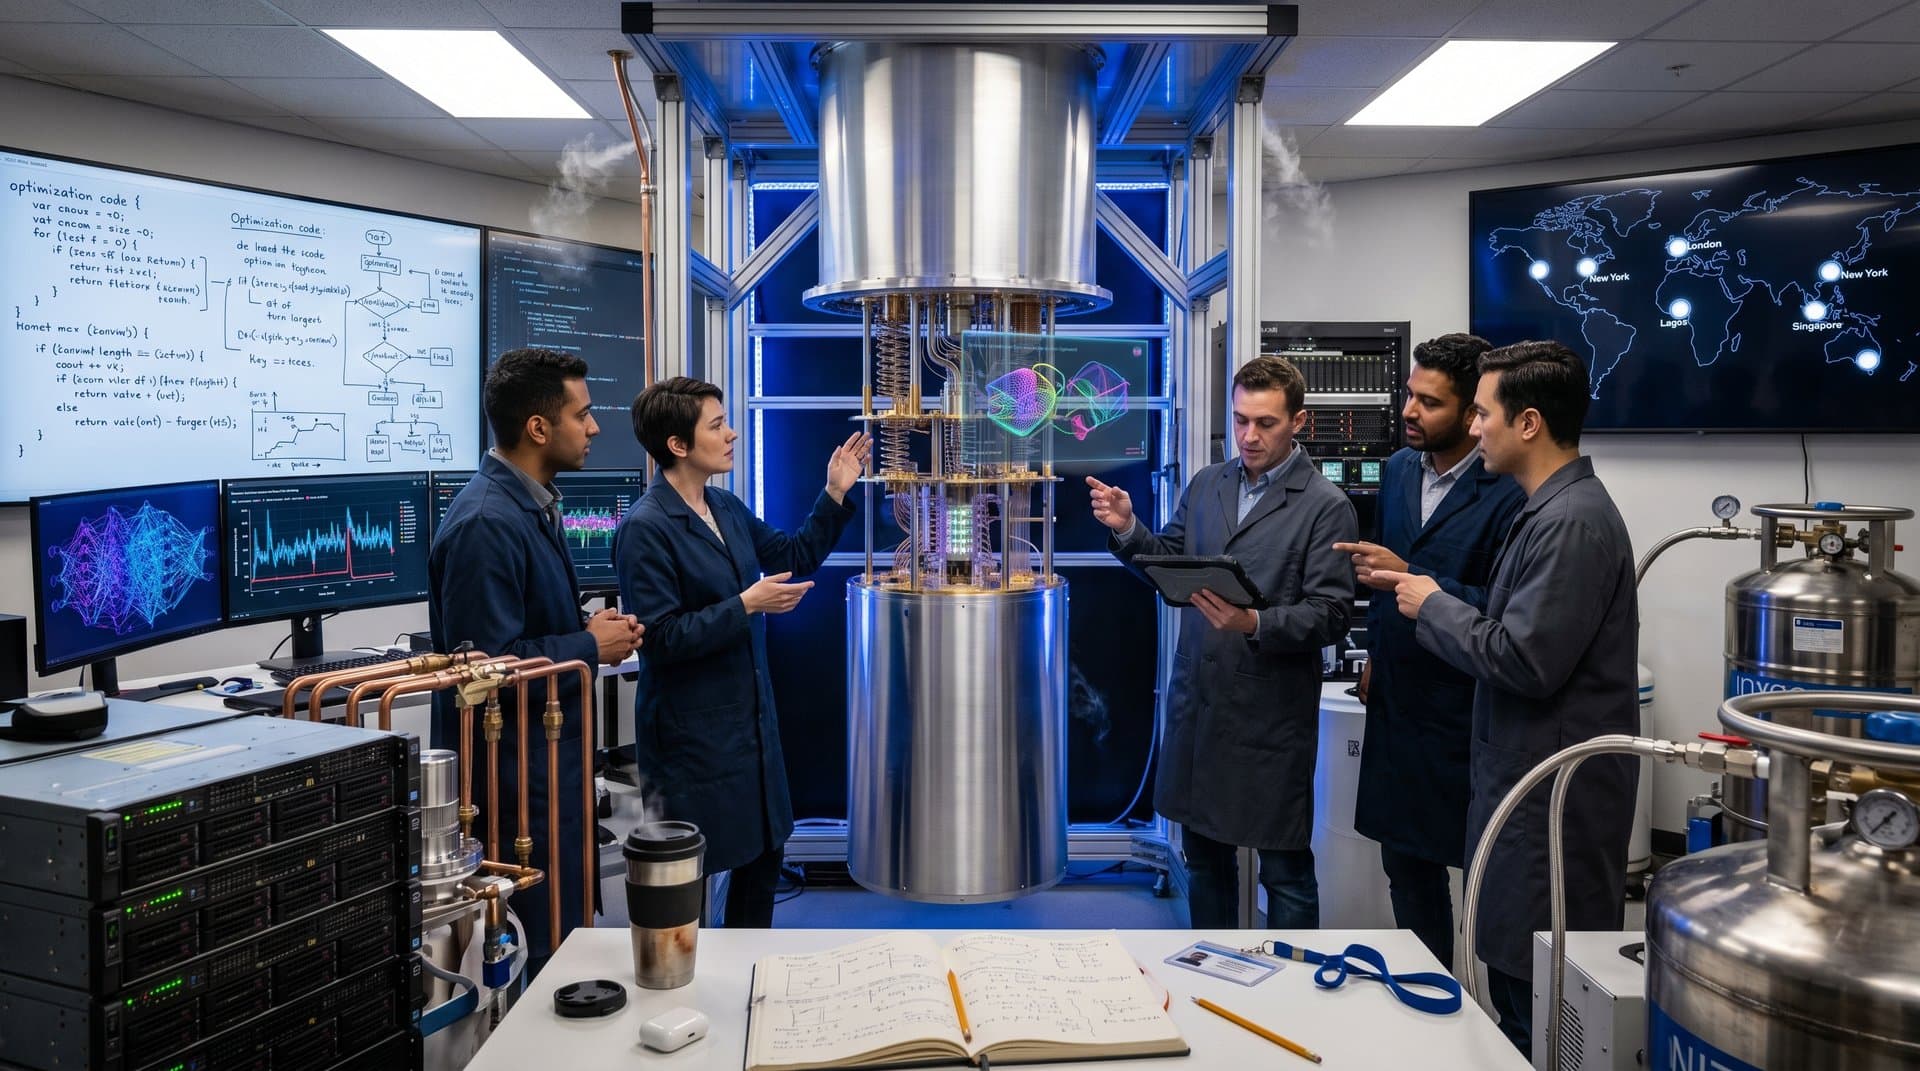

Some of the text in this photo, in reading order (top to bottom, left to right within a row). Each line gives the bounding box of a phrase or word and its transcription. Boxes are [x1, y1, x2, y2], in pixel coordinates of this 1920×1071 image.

[10, 180, 140, 210] optimization code {
[33, 201, 52, 210] var
[33, 216, 52, 224] vat
[109, 225, 130, 235] size
[231, 212, 294, 230] Optimization
[33, 227, 51, 238] for
[52, 245, 62, 254] if
[236, 240, 249, 251] de
[1687, 240, 1722, 250] London
[244, 257, 272, 268] option
[1589, 272, 1630, 283] New York
[1841, 268, 1888, 280] New York
[70, 276, 103, 286] return
[267, 311, 287, 321] turn
[1660, 318, 1688, 328] Lagos
[1792, 320, 1844, 332] Singapore
[36, 344, 46, 353] if
[99, 345, 132, 360] length
[249, 353, 267, 369] Key
[56, 373, 67, 383] if
[75, 389, 108, 398] return
[56, 402, 78, 412] else
[75, 417, 108, 426] return
